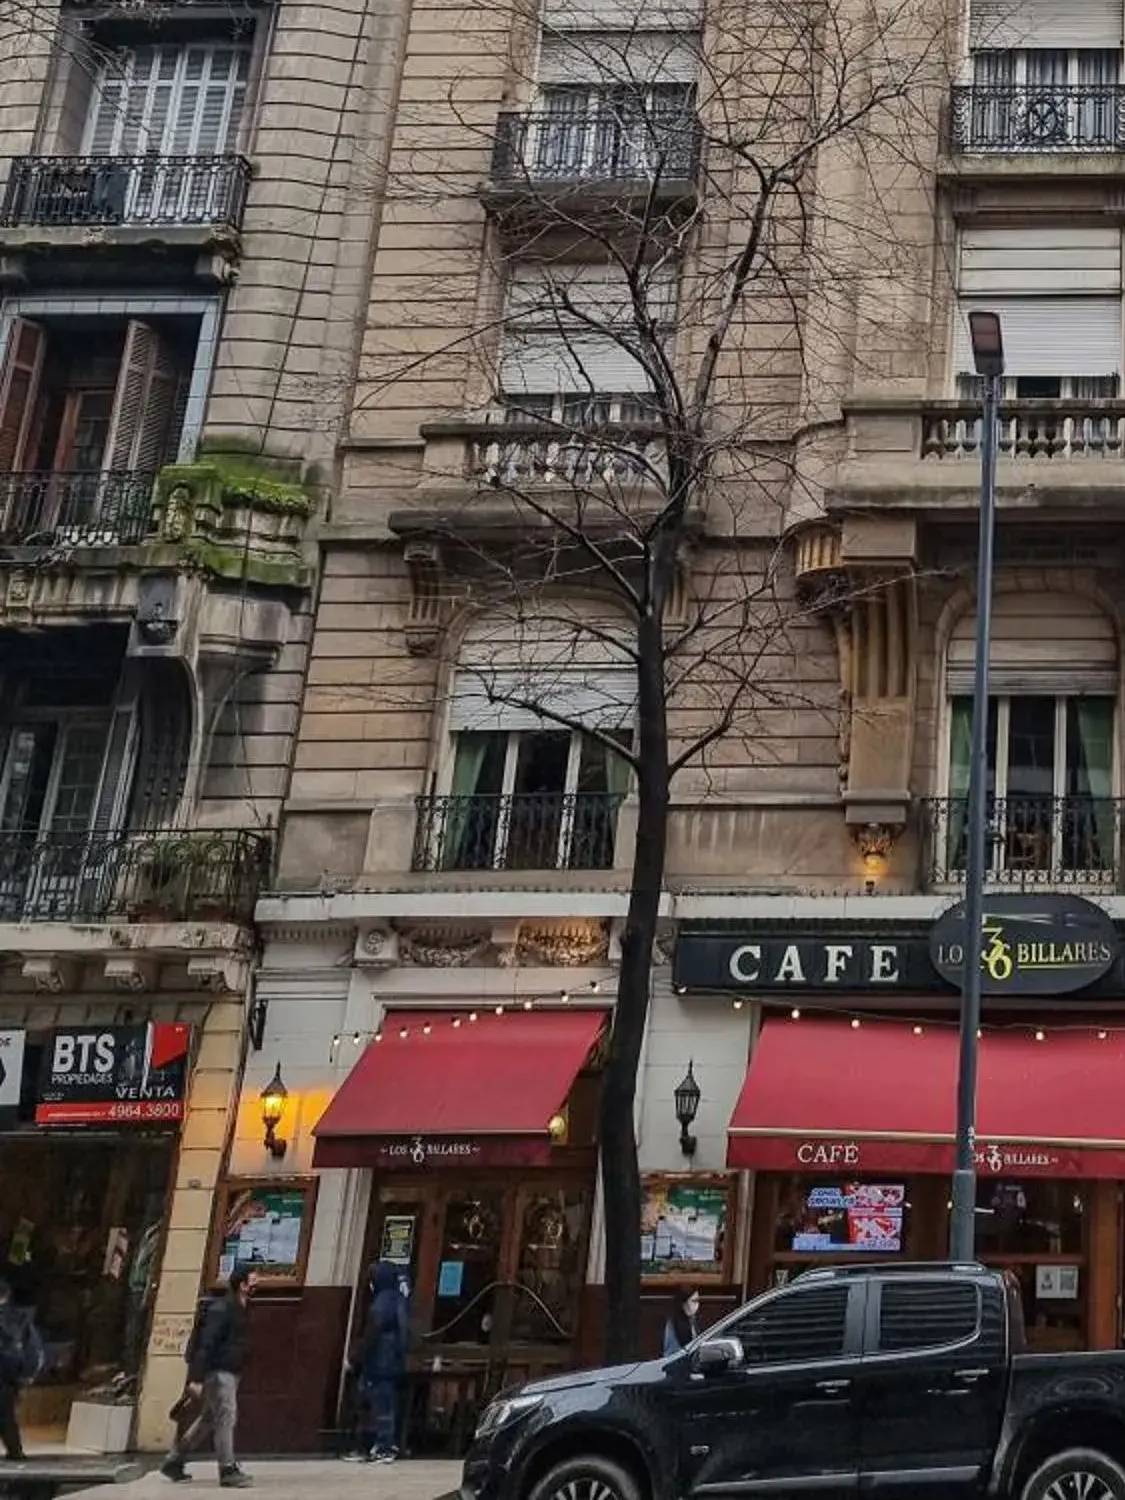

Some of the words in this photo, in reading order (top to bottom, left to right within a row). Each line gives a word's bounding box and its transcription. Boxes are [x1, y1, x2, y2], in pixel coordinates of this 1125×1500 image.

[729, 945, 900, 982] CAFE
[938, 944, 968, 964] LO
[1017, 941, 1112, 963] BILLARES
[52, 1033, 115, 1073] BTS
[116, 1086, 175, 1098] VENTA
